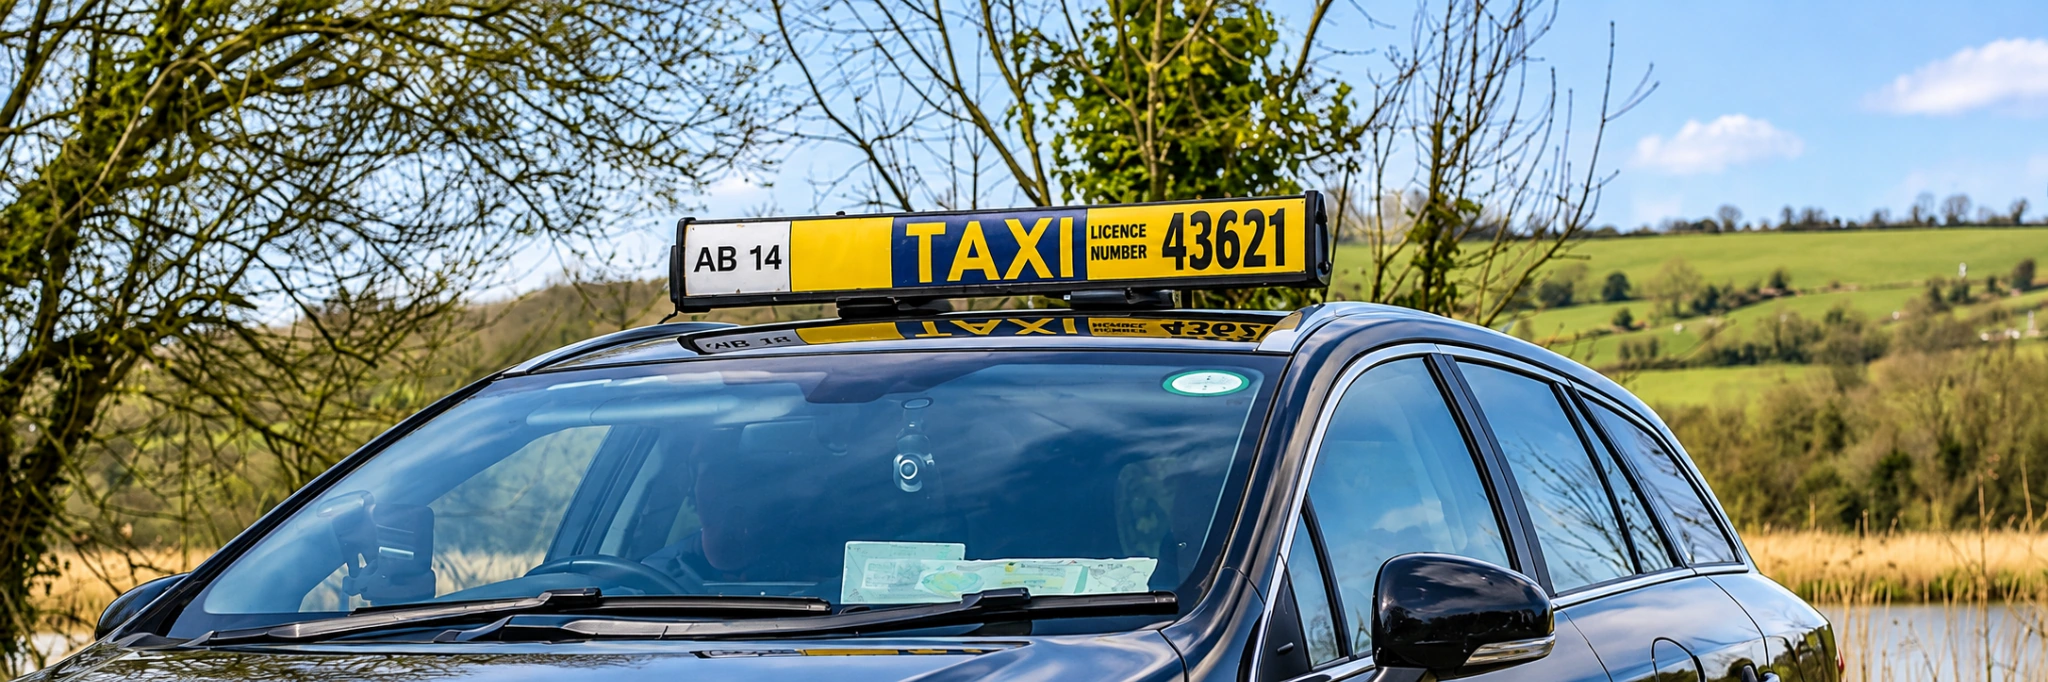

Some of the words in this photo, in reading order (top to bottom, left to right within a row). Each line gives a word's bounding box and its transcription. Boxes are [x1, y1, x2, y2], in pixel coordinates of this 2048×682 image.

[1090, 223, 1147, 240] LICENCE
[1161, 207, 1286, 270] 43621
[693, 246, 737, 273] AB
[749, 244, 782, 271] 14
[905, 216, 1075, 284] TAXI
[1090, 244, 1147, 261] NUMBER
